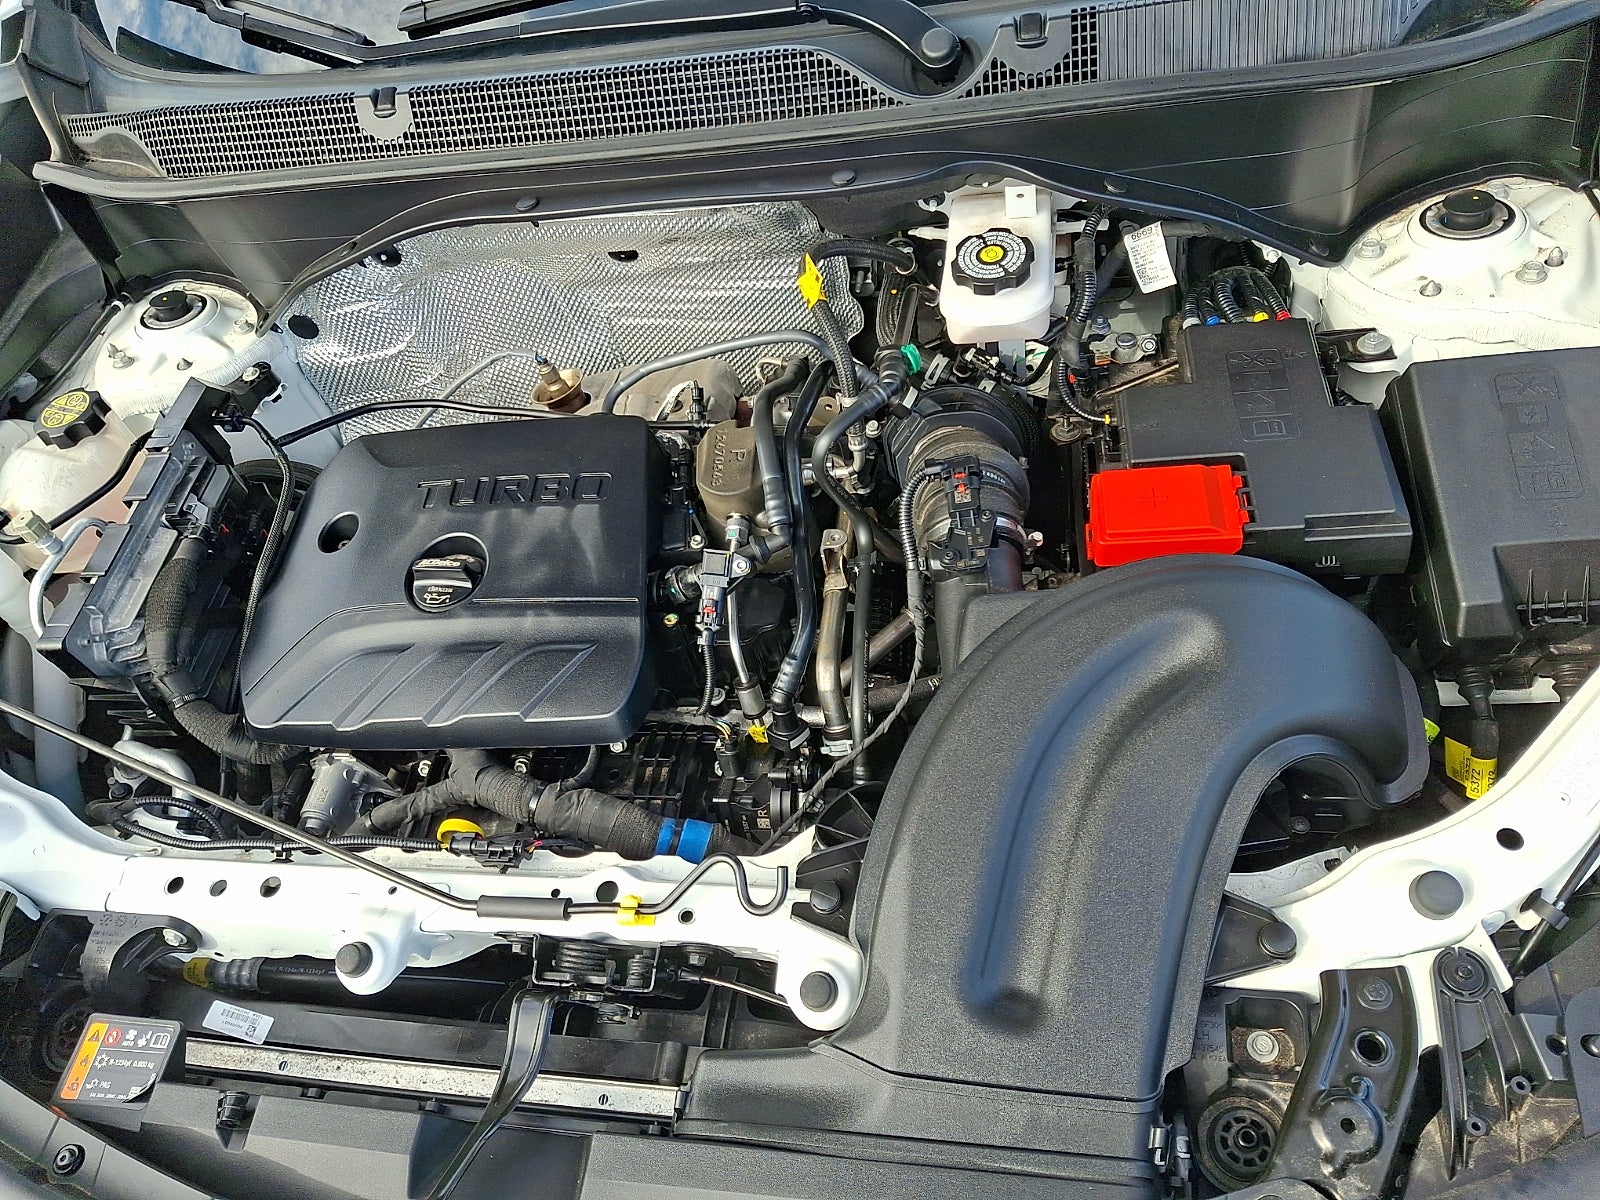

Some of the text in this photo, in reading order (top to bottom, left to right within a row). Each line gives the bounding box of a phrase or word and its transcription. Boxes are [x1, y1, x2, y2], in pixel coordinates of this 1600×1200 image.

[1131, 226, 1153, 240] 6669
[417, 472, 613, 509] TURBO
[1470, 768, 1481, 794] 5372
[757, 809, 769, 818] R
